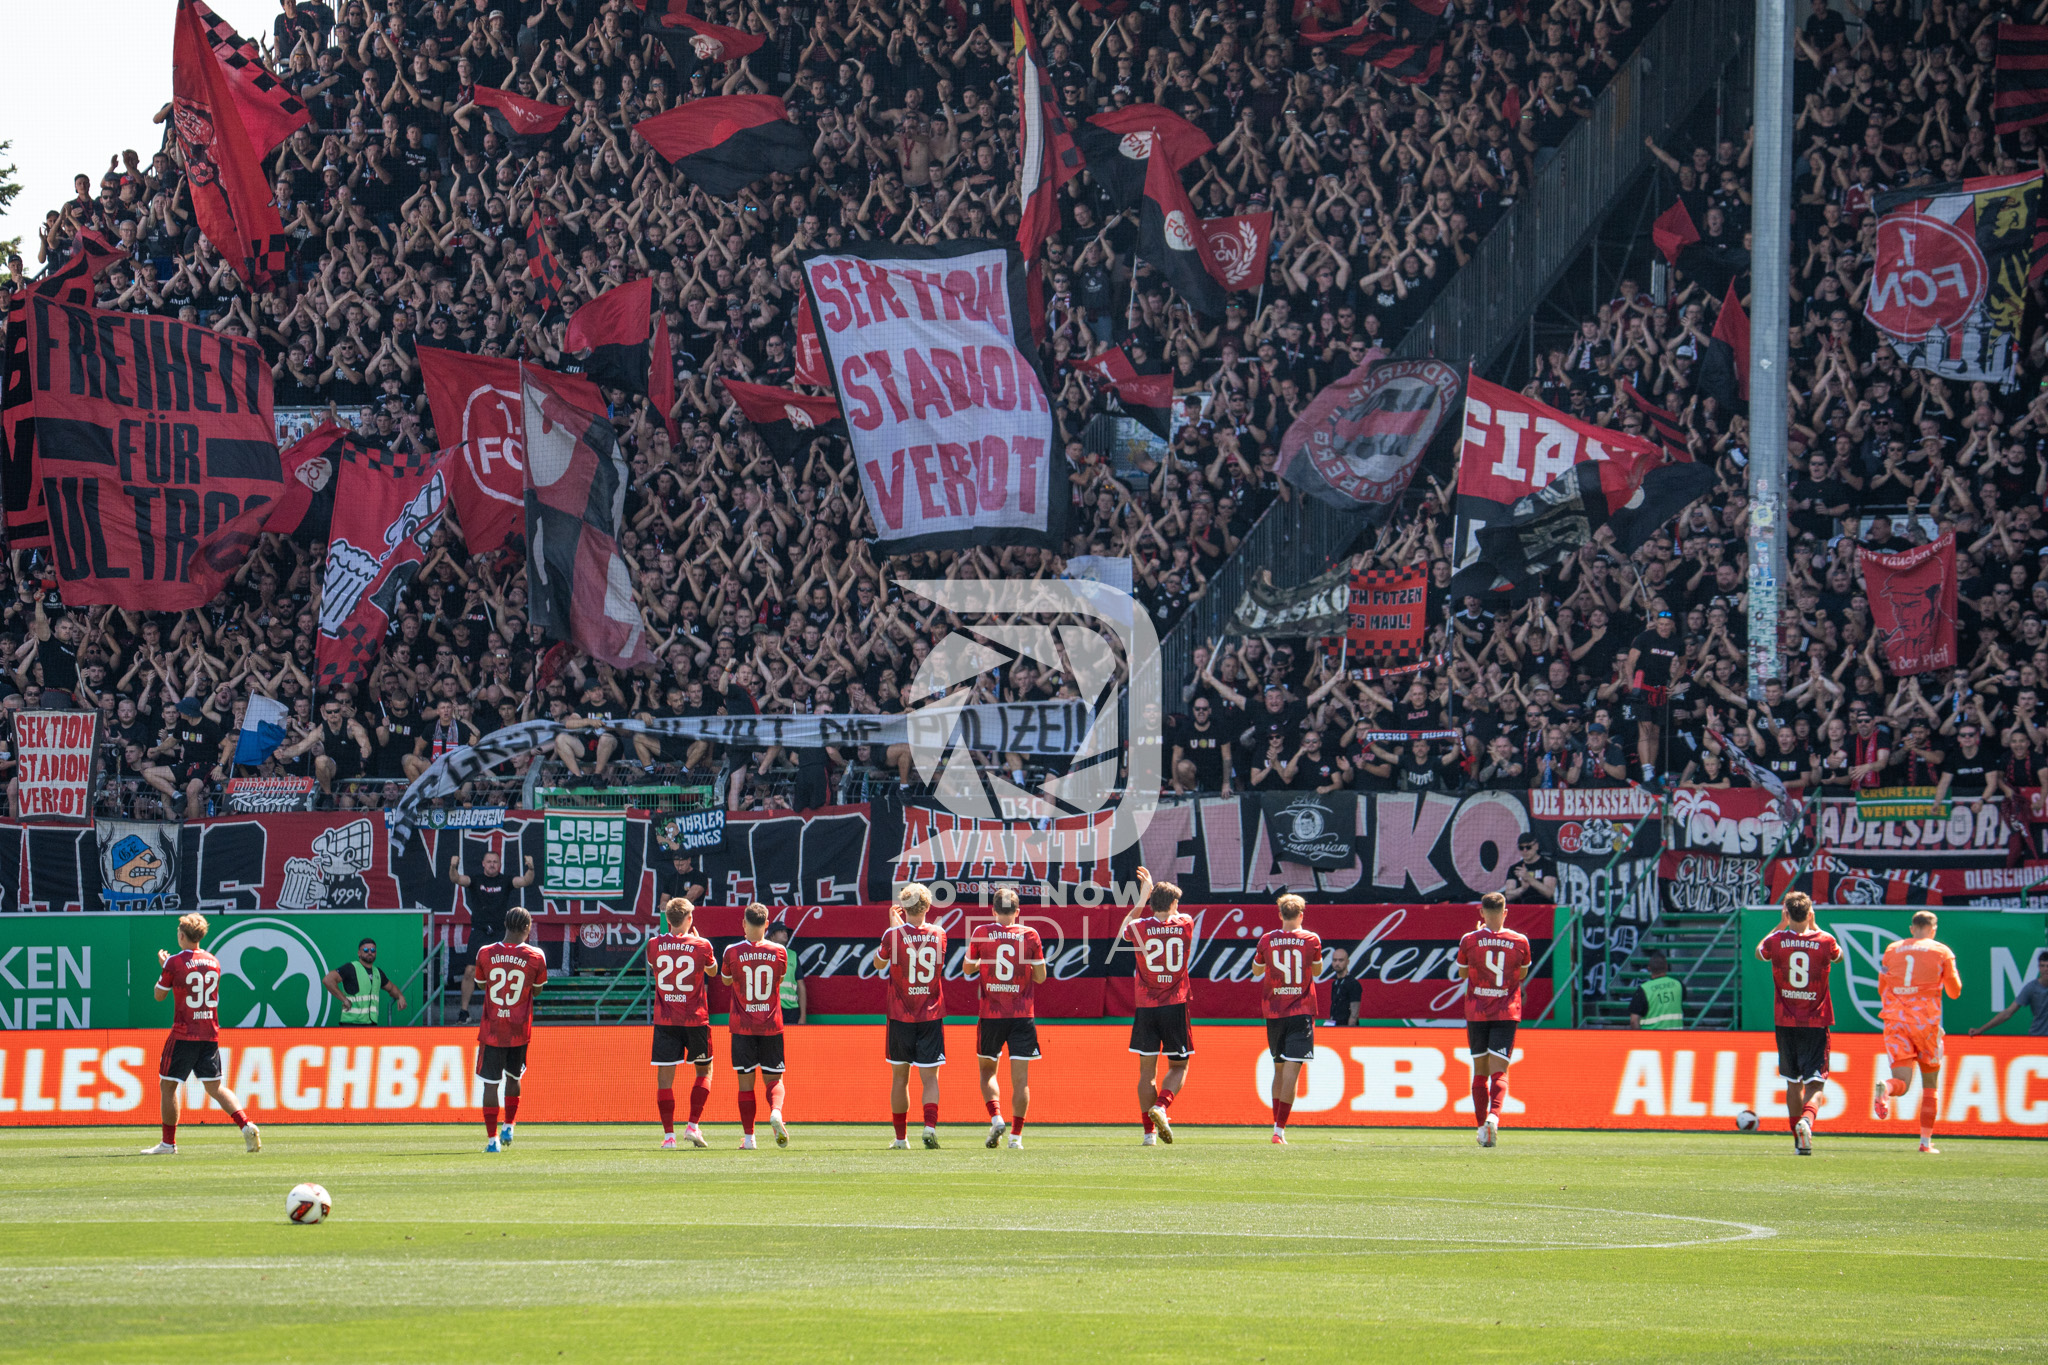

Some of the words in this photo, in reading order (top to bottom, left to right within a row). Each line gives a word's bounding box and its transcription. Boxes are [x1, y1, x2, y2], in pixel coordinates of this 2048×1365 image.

[33, 303, 266, 416] FREIHEIT
[841, 344, 1048, 431] STADION
[118, 412, 201, 485] FÜR
[1372, 586, 1424, 606] FOTZEN
[1369, 613, 1412, 630] MAUL!
[16, 714, 94, 749] SEKTION
[18, 752, 90, 784] STADION
[18, 786, 85, 817] VERBOT
[233, 779, 308, 792] DURCHHALTEN
[447, 807, 505, 827] CHAOTEN
[1532, 788, 1560, 816] DIE
[546, 819, 624, 843] LORDS
[675, 809, 725, 833] MARLER
[546, 844, 623, 866] RAPID
[682, 829, 722, 850] JUNGS
[893, 804, 1117, 892] AVANTI
[546, 867, 622, 889] 2004
[331, 887, 363, 902] 1994
[658, 942, 695, 953] NÜRNBERG
[1147, 927, 1183, 936] NÜRNBERG
[1780, 939, 1820, 950] NÜRNBERG
[739, 952, 777, 963] NÜRNBERG
[906, 946, 937, 984] 19
[995, 943, 1015, 981] 6
[1145, 937, 1184, 972] 20
[1272, 949, 1303, 985] 41
[1485, 950, 1506, 987] 4
[1789, 951, 1810, 989] 8
[1904, 954, 1915, 987] 1
[186, 970, 219, 1008] 32
[489, 967, 526, 1006] 23
[656, 955, 695, 992] 22
[742, 964, 774, 1001] 10
[1657, 991, 1675, 1004] 151
[1255, 1044, 1527, 1114] OBI
[1612, 1048, 1848, 1121] ALLES
